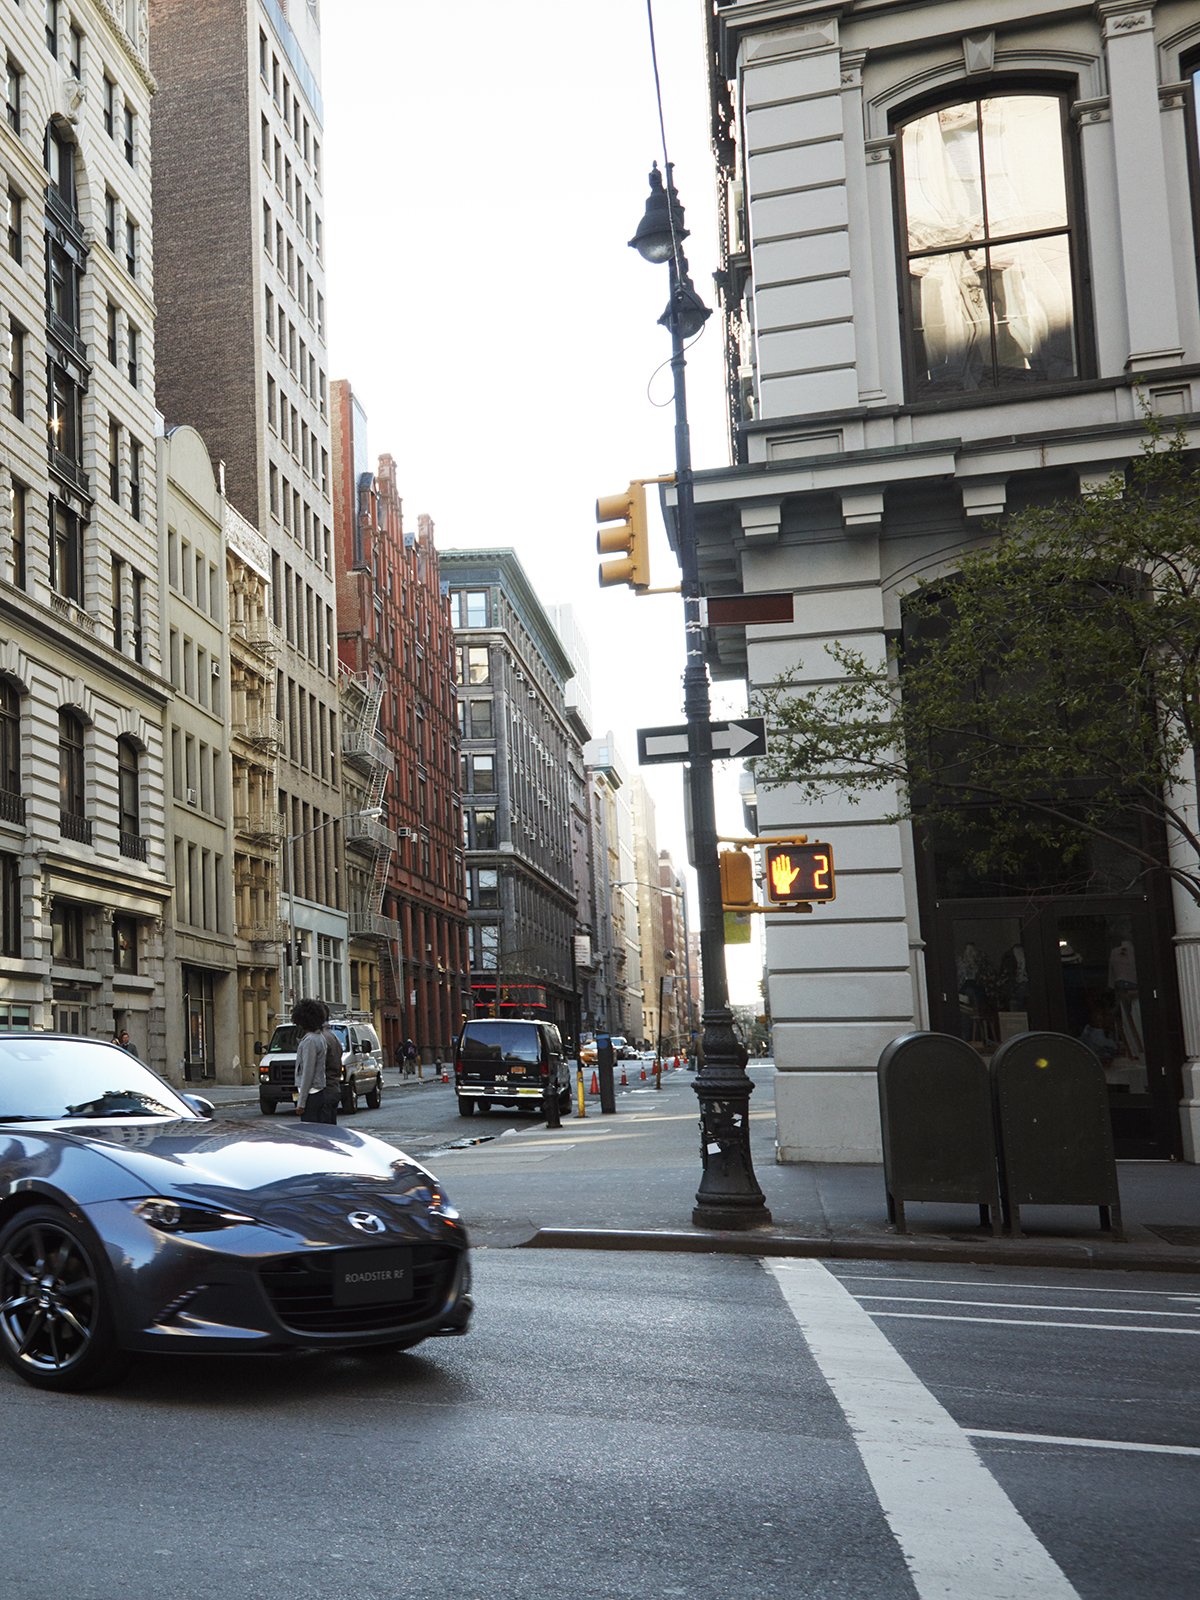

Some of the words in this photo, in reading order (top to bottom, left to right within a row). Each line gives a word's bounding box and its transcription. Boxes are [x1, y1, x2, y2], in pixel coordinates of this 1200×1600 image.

[813, 855, 829, 890] 2
[344, 1270, 393, 1283] ROADSTER
[393, 1269, 405, 1279] RF
